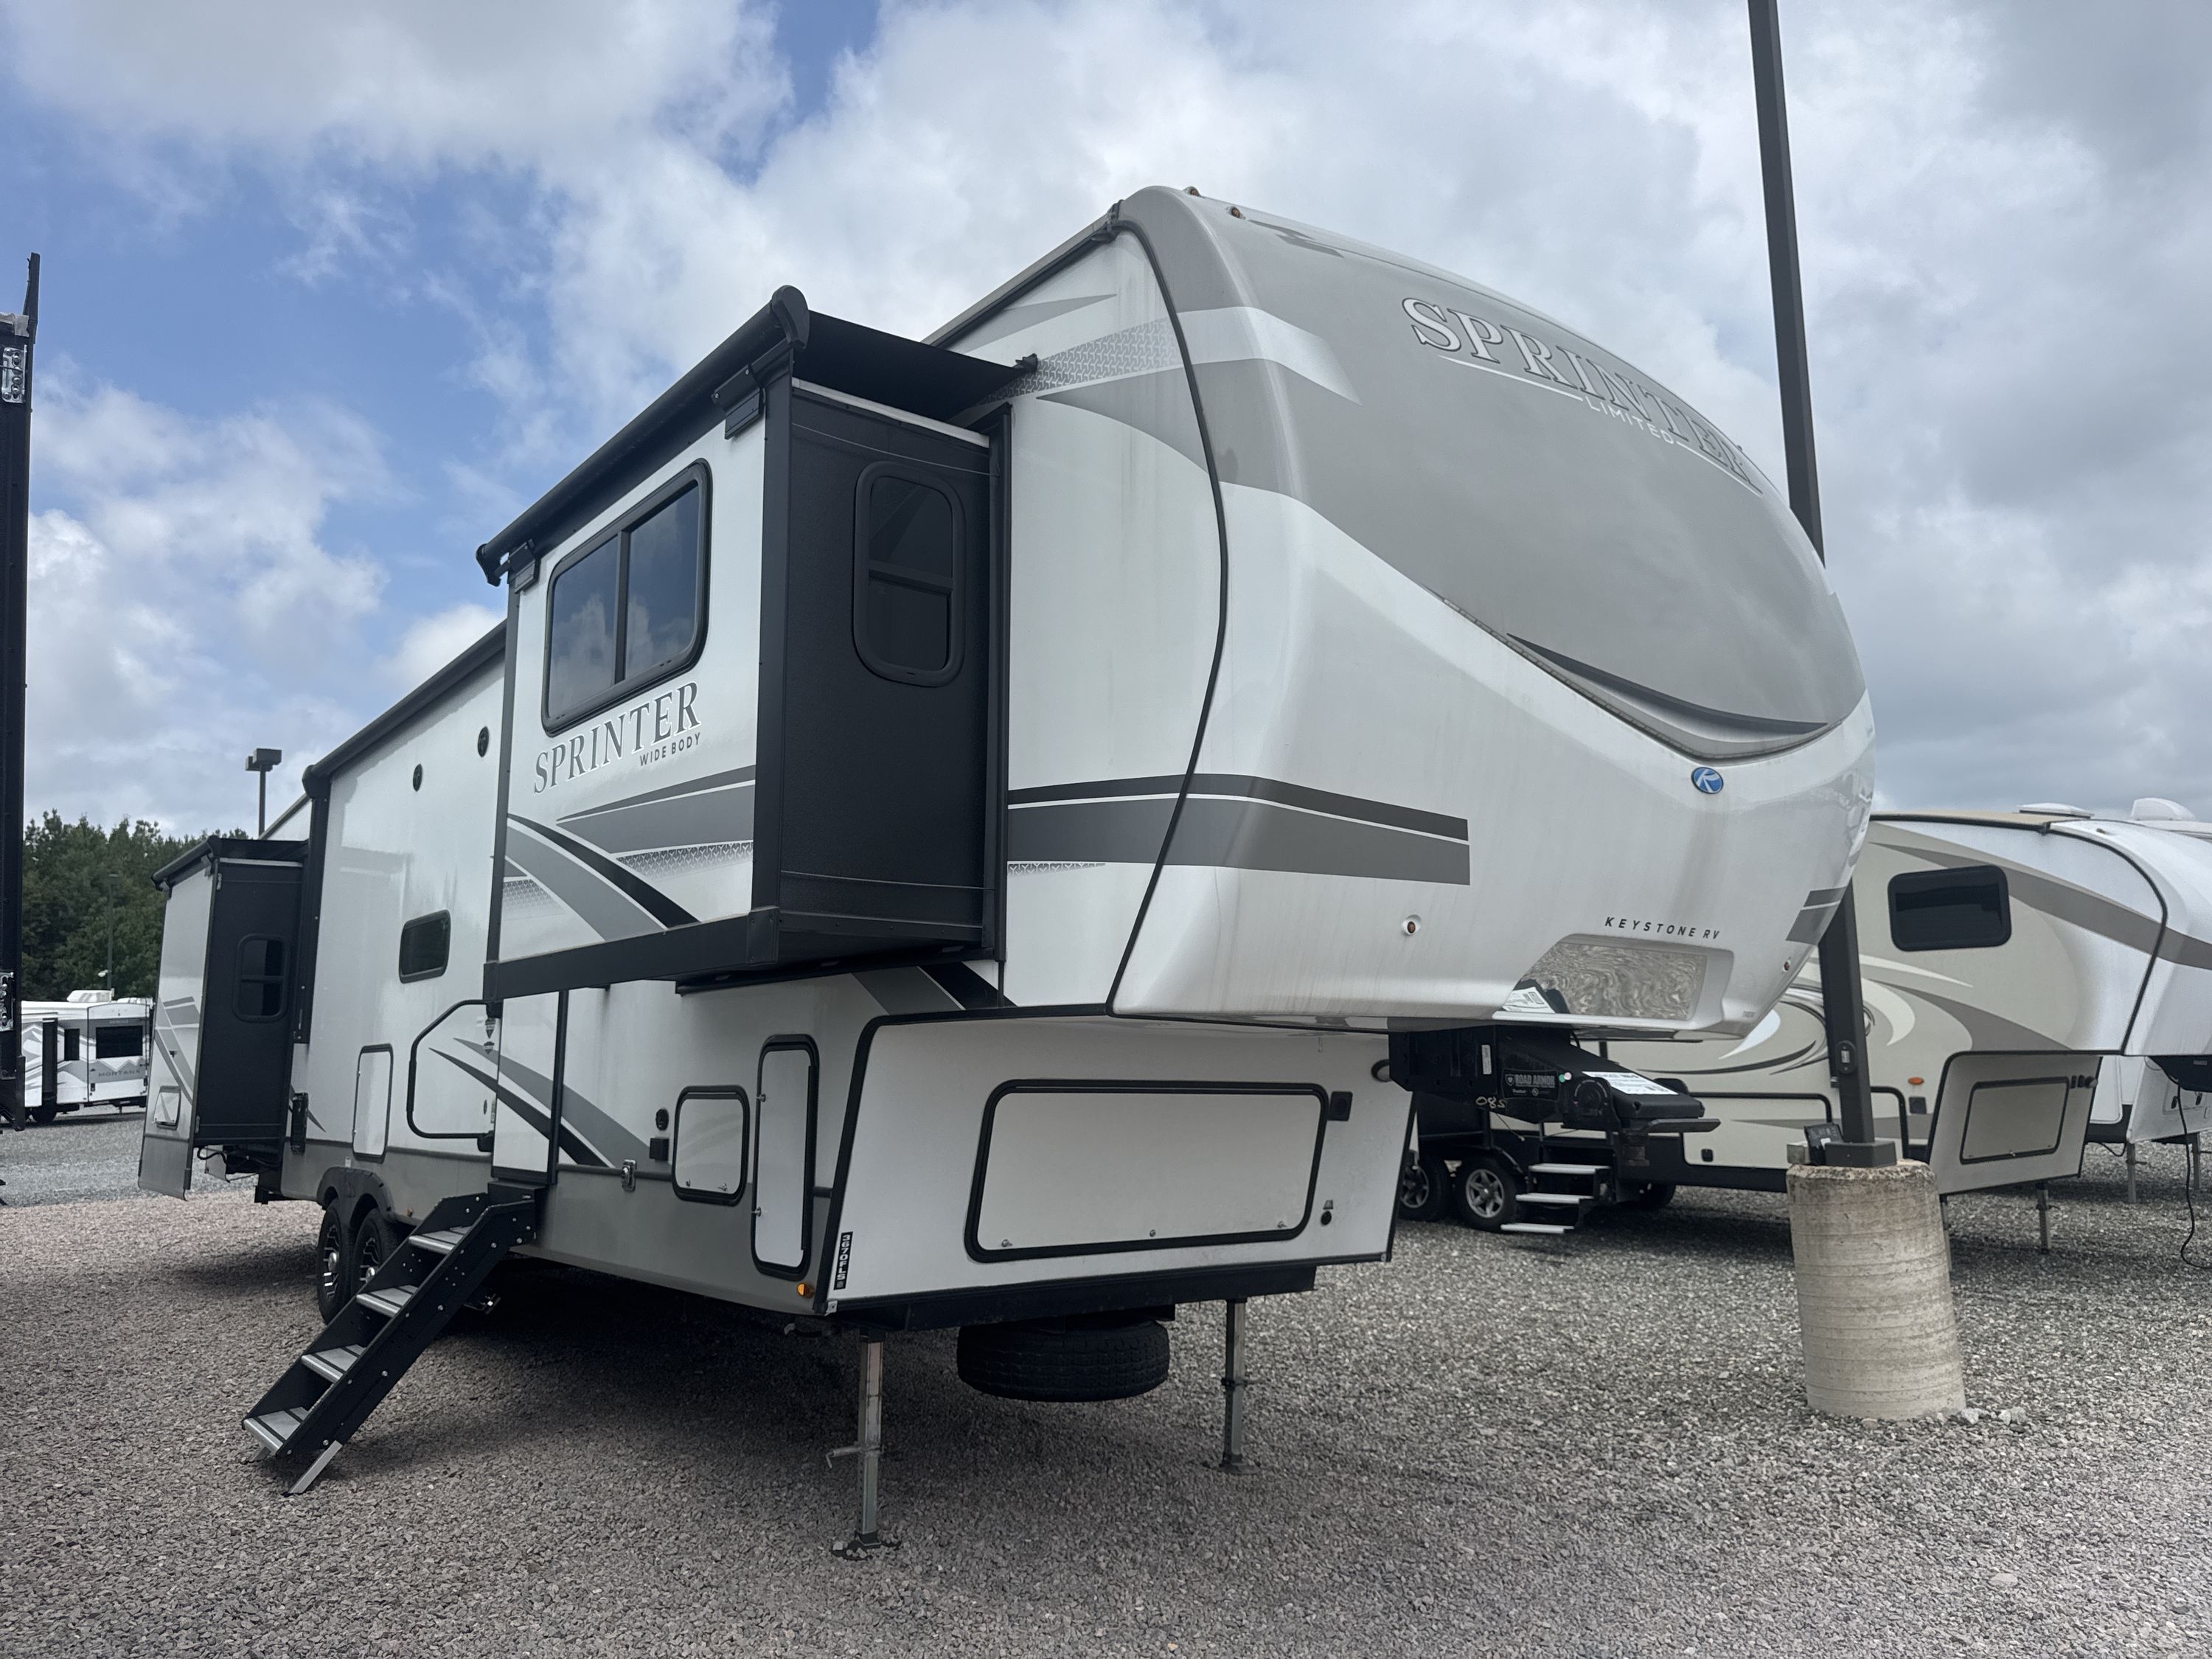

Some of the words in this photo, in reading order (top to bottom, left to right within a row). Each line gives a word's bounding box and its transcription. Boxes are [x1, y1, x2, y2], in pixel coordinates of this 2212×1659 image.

[1402, 297, 1763, 495] SPRINTER
[1585, 396, 1676, 445] LIMITED
[533, 682, 702, 795] SPRINTER
[639, 745, 667, 767] WIDE
[671, 732, 701, 755] BODY
[1604, 917, 1697, 937] KEYSTONE
[1703, 929, 1721, 940] RV
[98, 1069, 141, 1077] MONTANA
[1514, 1074, 1532, 1085] ROAD
[837, 1234, 851, 1281] 3670FLS
